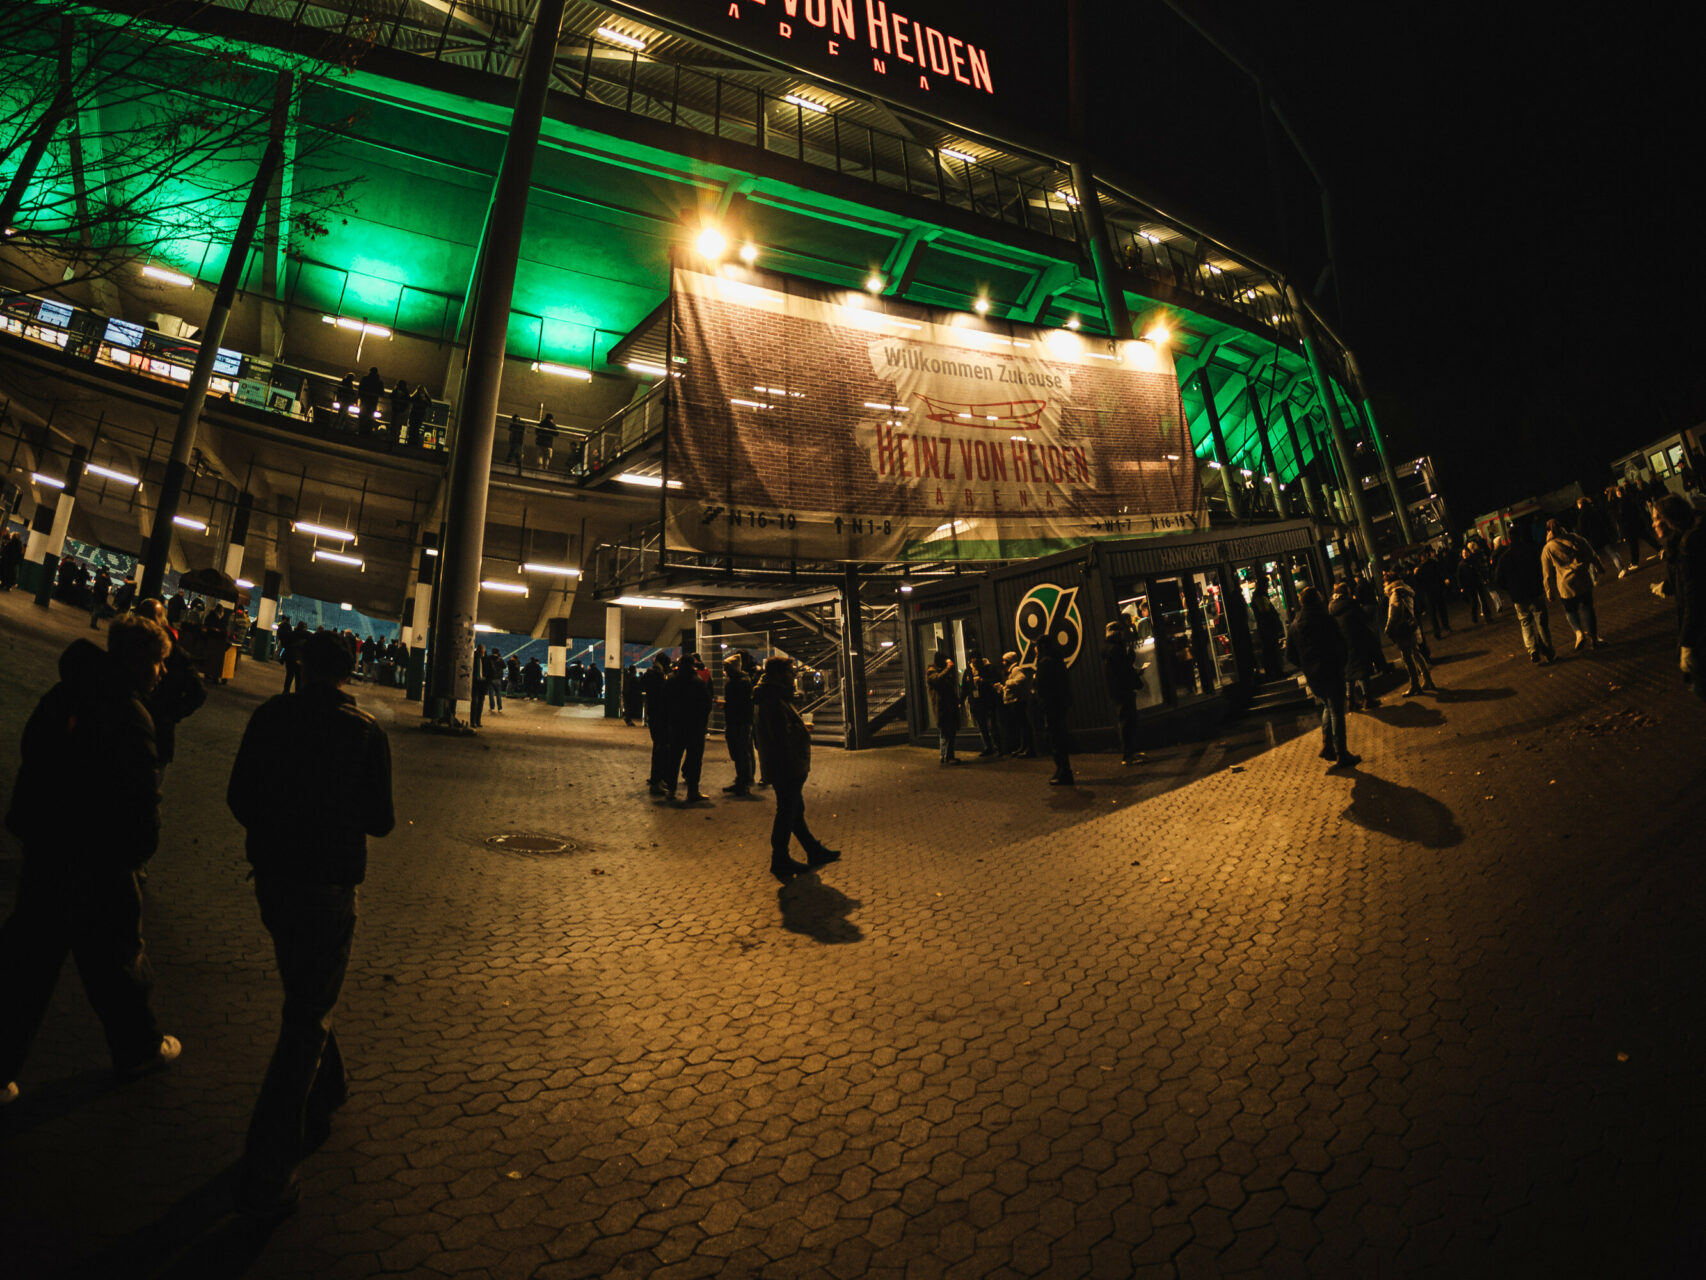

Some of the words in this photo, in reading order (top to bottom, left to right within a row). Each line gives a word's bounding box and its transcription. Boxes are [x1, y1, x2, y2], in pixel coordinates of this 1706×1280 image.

[728, 3, 930, 91] ARENA
[884, 345, 993, 381] Willkommen
[999, 363, 1063, 389] Zuhause
[876, 423, 956, 481] HEINZ
[958, 438, 1008, 482] VON
[1010, 437, 1090, 484] HEIDEN
[936, 487, 1054, 507] ARENA
[730, 508, 742, 527] N
[748, 511, 796, 530] 16-19
[852, 518, 863, 534] N
[868, 518, 892, 535] 1-8
[1151, 516, 1160, 530] N
